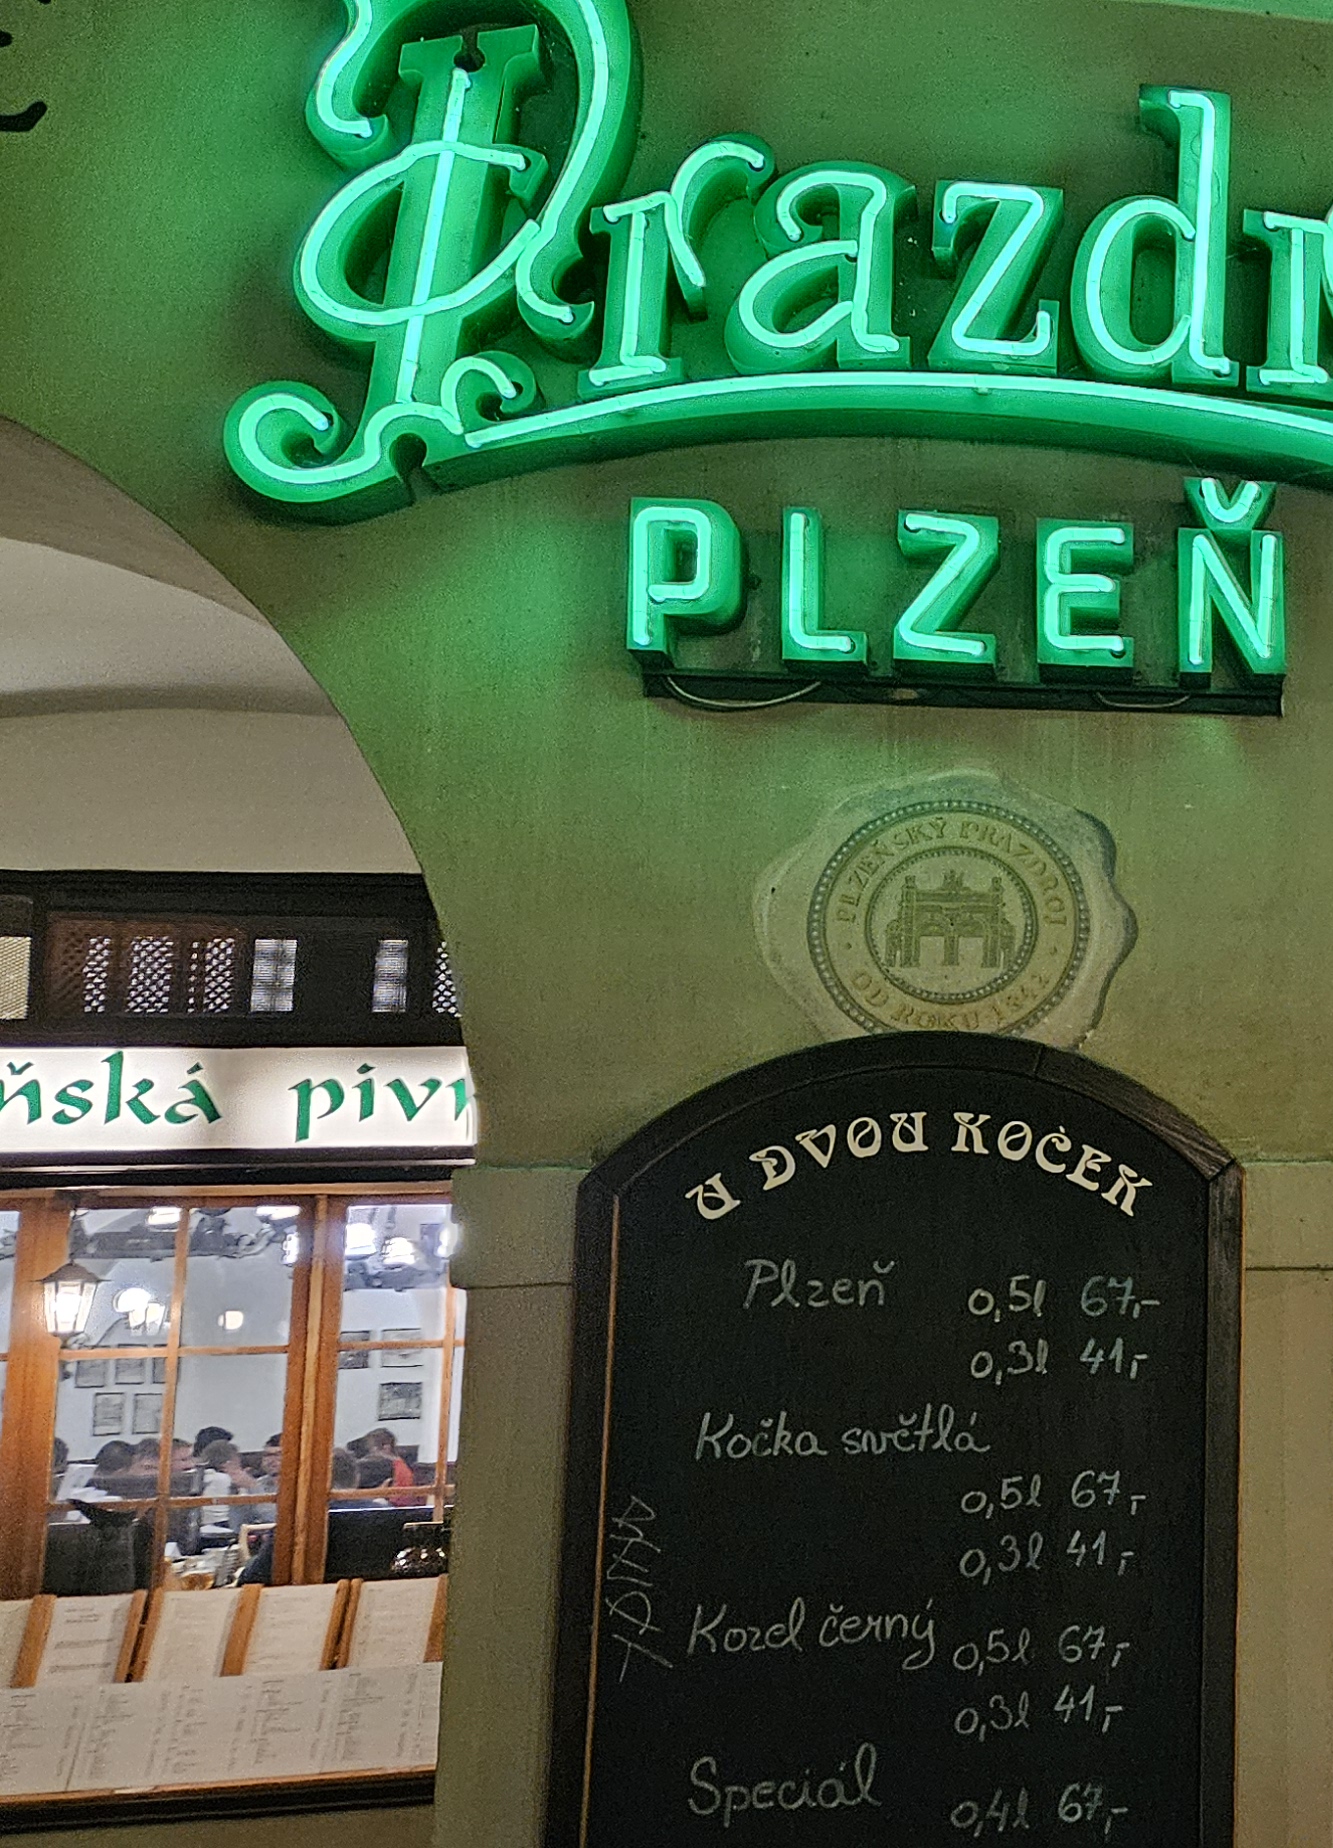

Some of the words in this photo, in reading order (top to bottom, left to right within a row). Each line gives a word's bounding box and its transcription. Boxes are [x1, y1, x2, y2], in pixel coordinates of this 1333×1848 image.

[625, 475, 1284, 683] PLZEŇ
[958, 819, 1068, 928] PRAZDROJ
[685, 1173, 741, 1220] U
[749, 1111, 929, 1192] DVOU
[950, 1110, 1153, 1217] KOČEK
[742, 1257, 896, 1309] Plzeň
[694, 1410, 829, 1461] Kočka
[686, 1596, 805, 1656] Kozel
[818, 1598, 939, 1671] černý
[687, 1741, 882, 1829] Speciál
